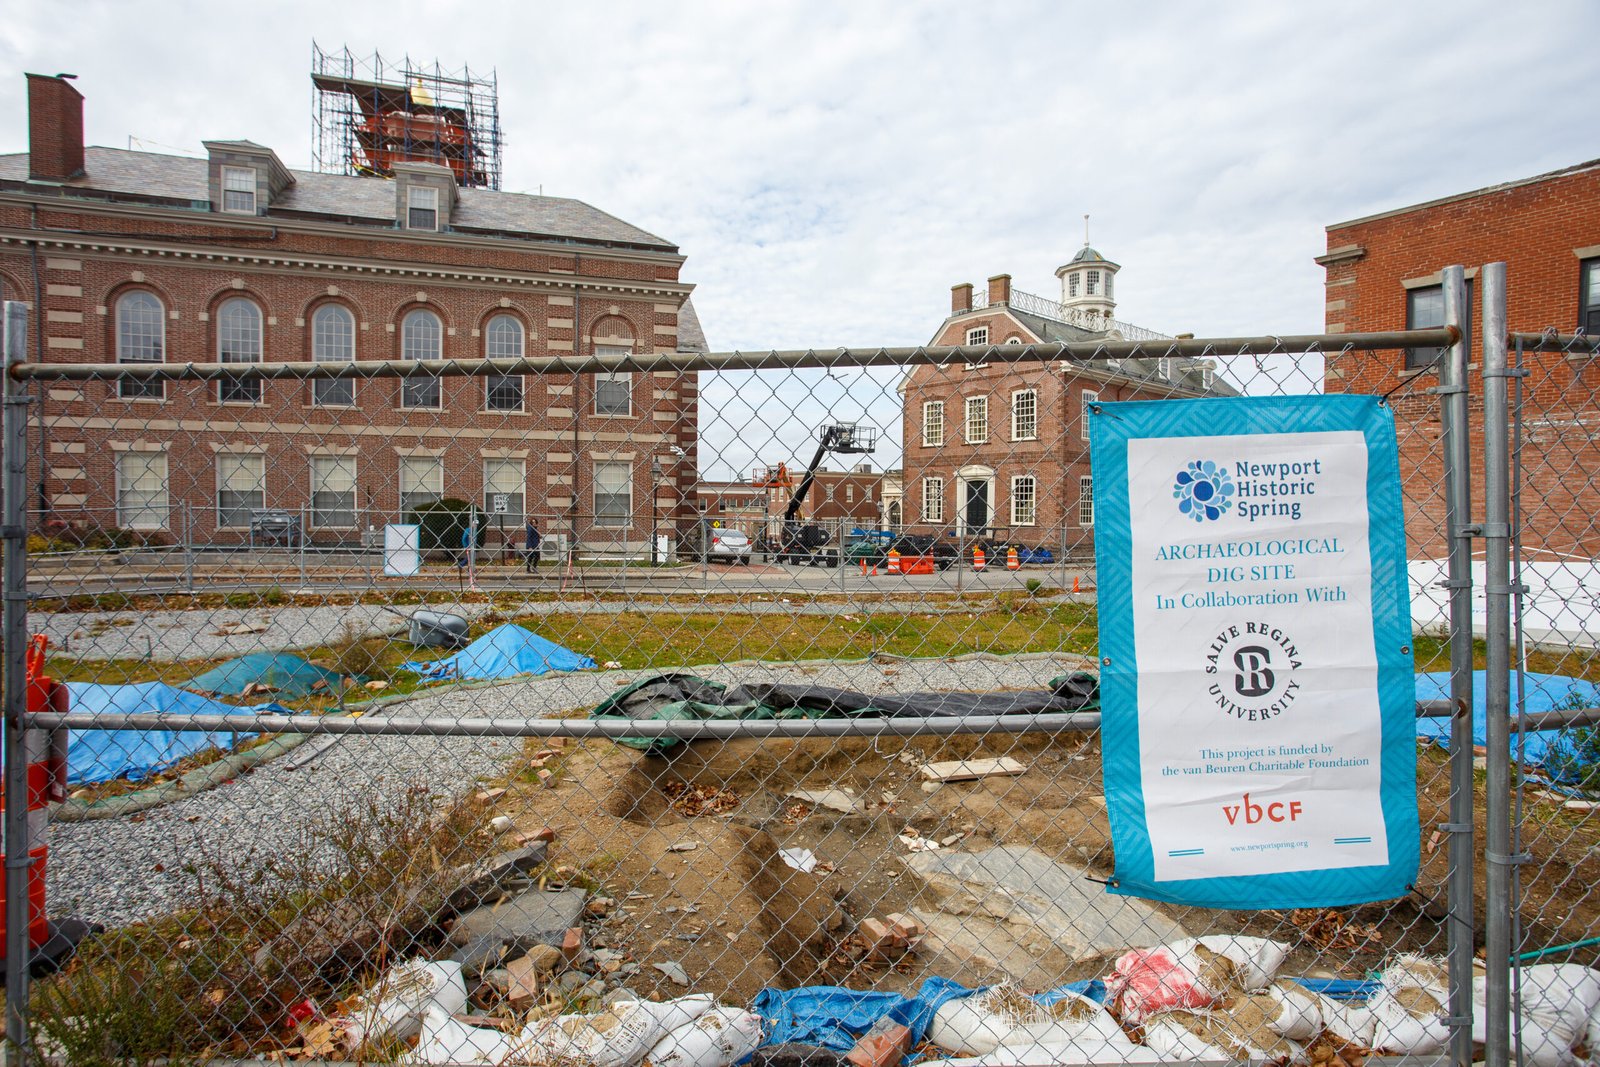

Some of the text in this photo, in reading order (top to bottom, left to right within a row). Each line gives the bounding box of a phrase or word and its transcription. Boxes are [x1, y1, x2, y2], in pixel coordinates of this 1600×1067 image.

[1236, 459, 1321, 480] Newport
[1237, 477, 1315, 497] Historic
[1238, 499, 1302, 521] Spring
[1155, 538, 1345, 561] ARCHAEOLOGICAL
[1207, 564, 1296, 583] DIG SITE
[1156, 586, 1347, 610] In Collaboration With
[1205, 621, 1302, 675] SALVE REGINA
[1208, 680, 1300, 721] UNIVERSITY
[1199, 743, 1334, 761] This project is funded by
[1162, 756, 1370, 776] the van Beuren Charitable Foundation
[1230, 840, 1309, 852] www.newportspring.org
